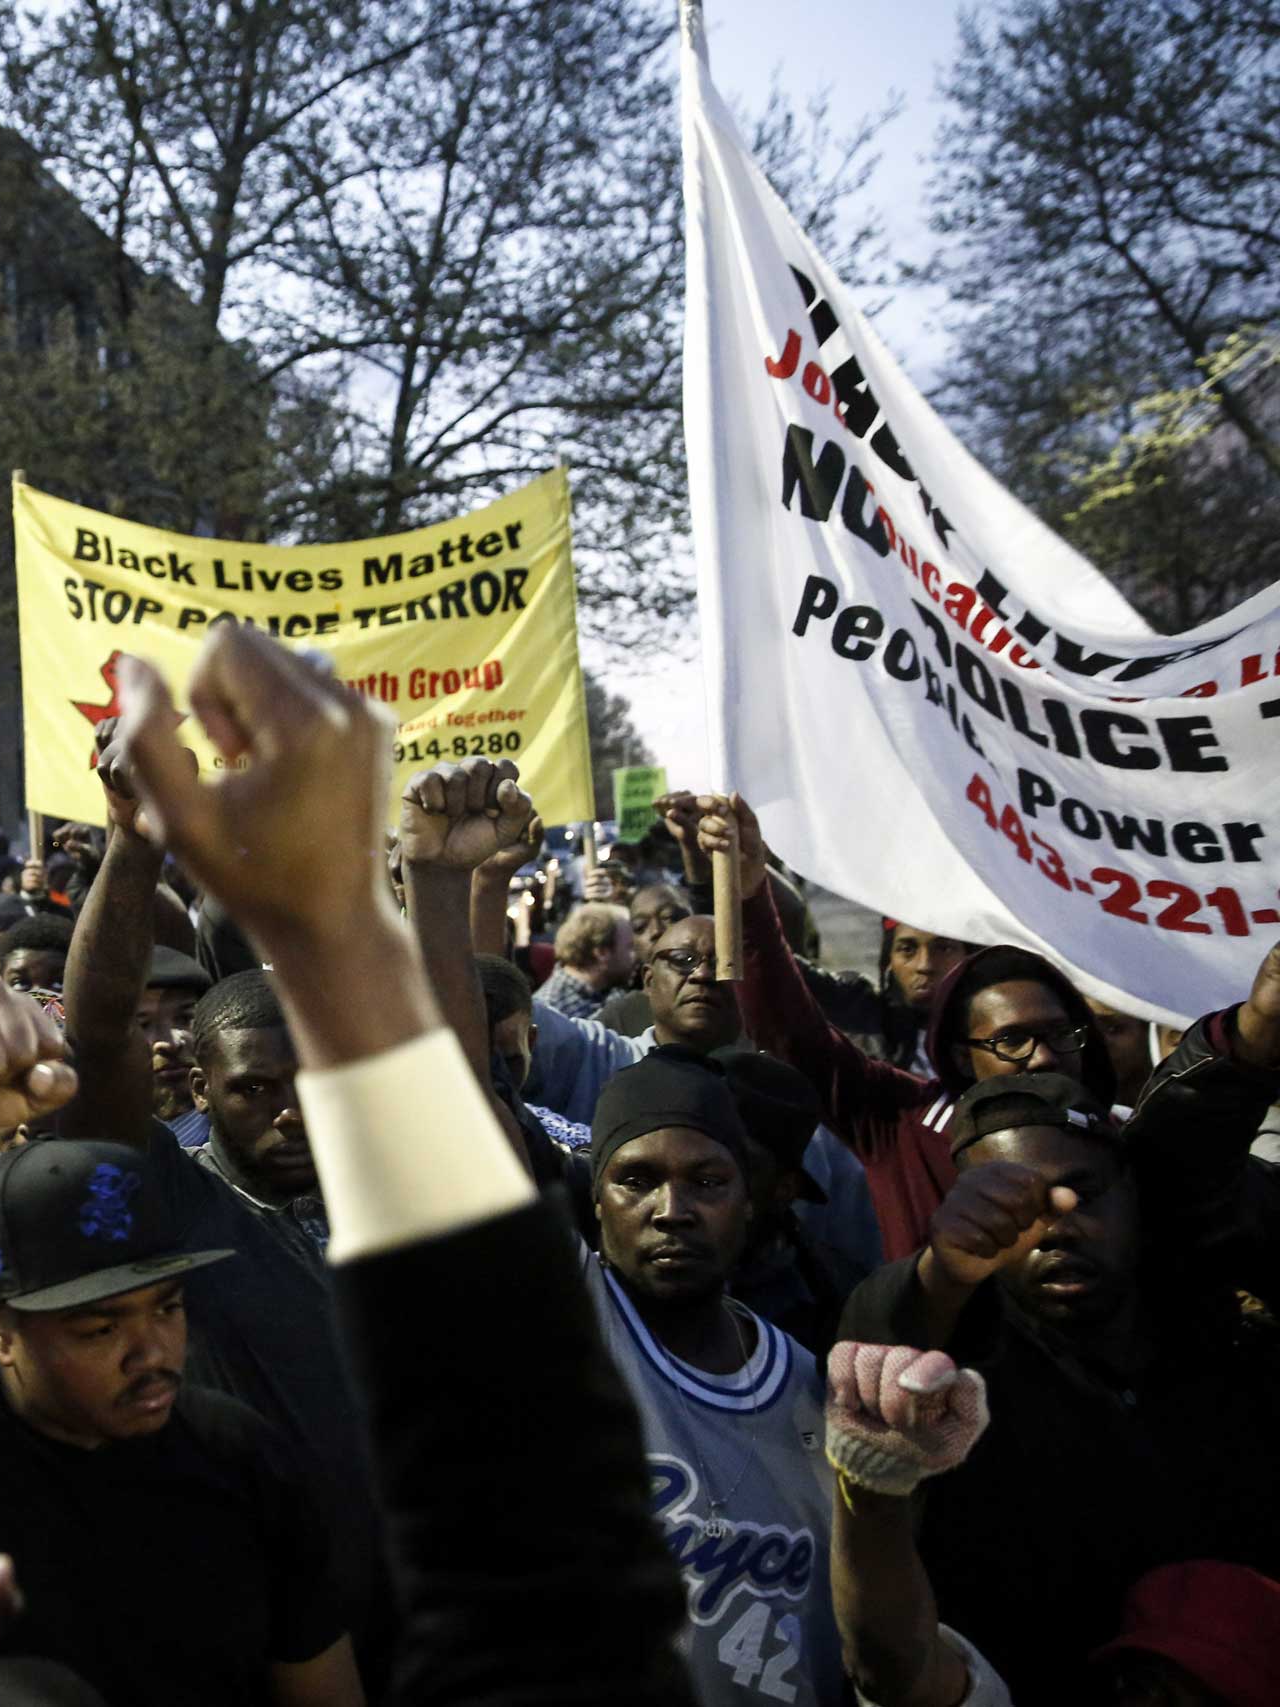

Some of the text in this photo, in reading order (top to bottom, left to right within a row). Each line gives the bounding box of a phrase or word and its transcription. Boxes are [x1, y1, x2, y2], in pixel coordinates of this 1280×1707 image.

[73, 519, 522, 593] Black Lives Matter
[63, 576, 165, 625] STOP
[352, 567, 530, 630] TERROR
[408, 659, 504, 701] Group
[446, 708, 527, 729] Together
[1017, 767, 1266, 863] Power
[718, 1600, 802, 1704] 42
